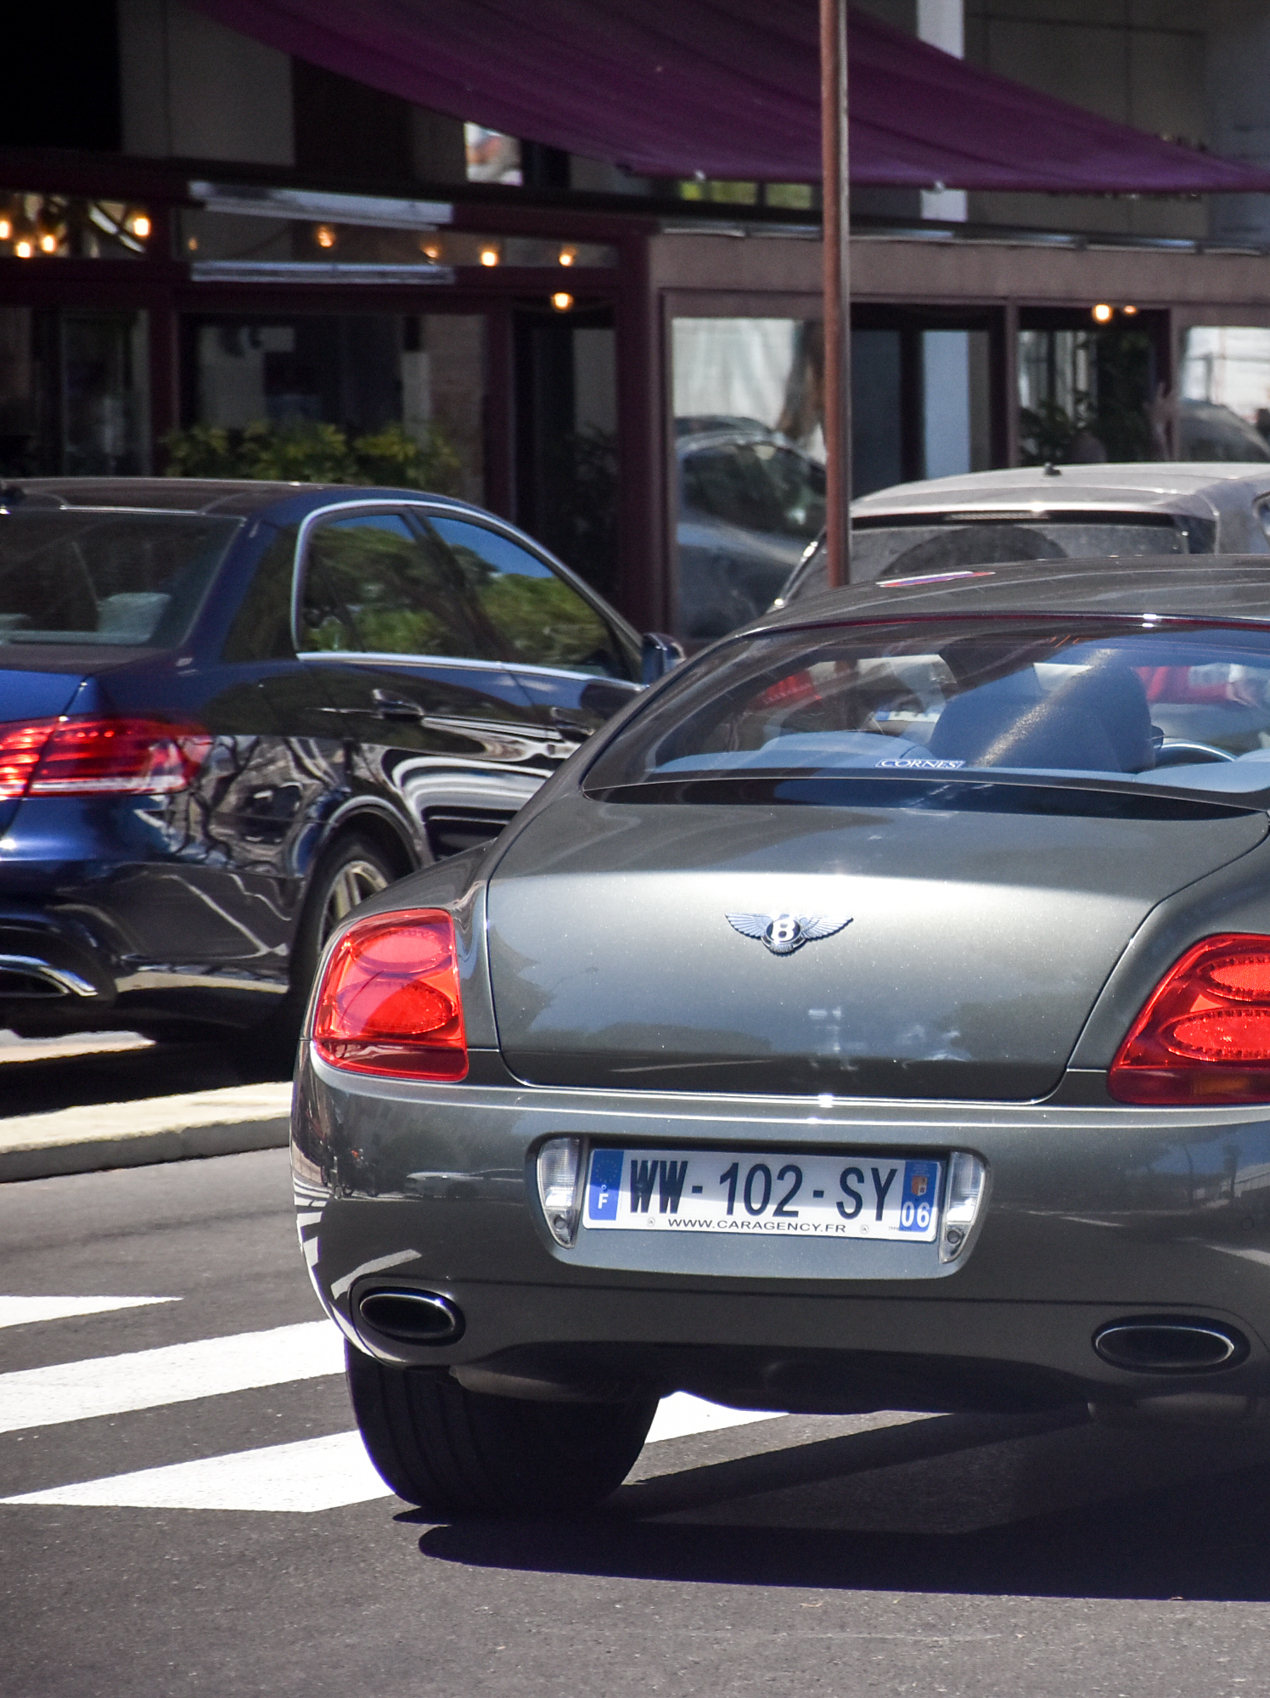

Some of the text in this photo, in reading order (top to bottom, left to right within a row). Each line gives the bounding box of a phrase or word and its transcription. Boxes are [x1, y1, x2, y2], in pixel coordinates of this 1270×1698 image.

[879, 759, 957, 769] CORNES
[597, 1193, 609, 1210] F
[901, 1201, 931, 1228] 06
[667, 1218, 847, 1234] WWW.CARAGENCY.FR
